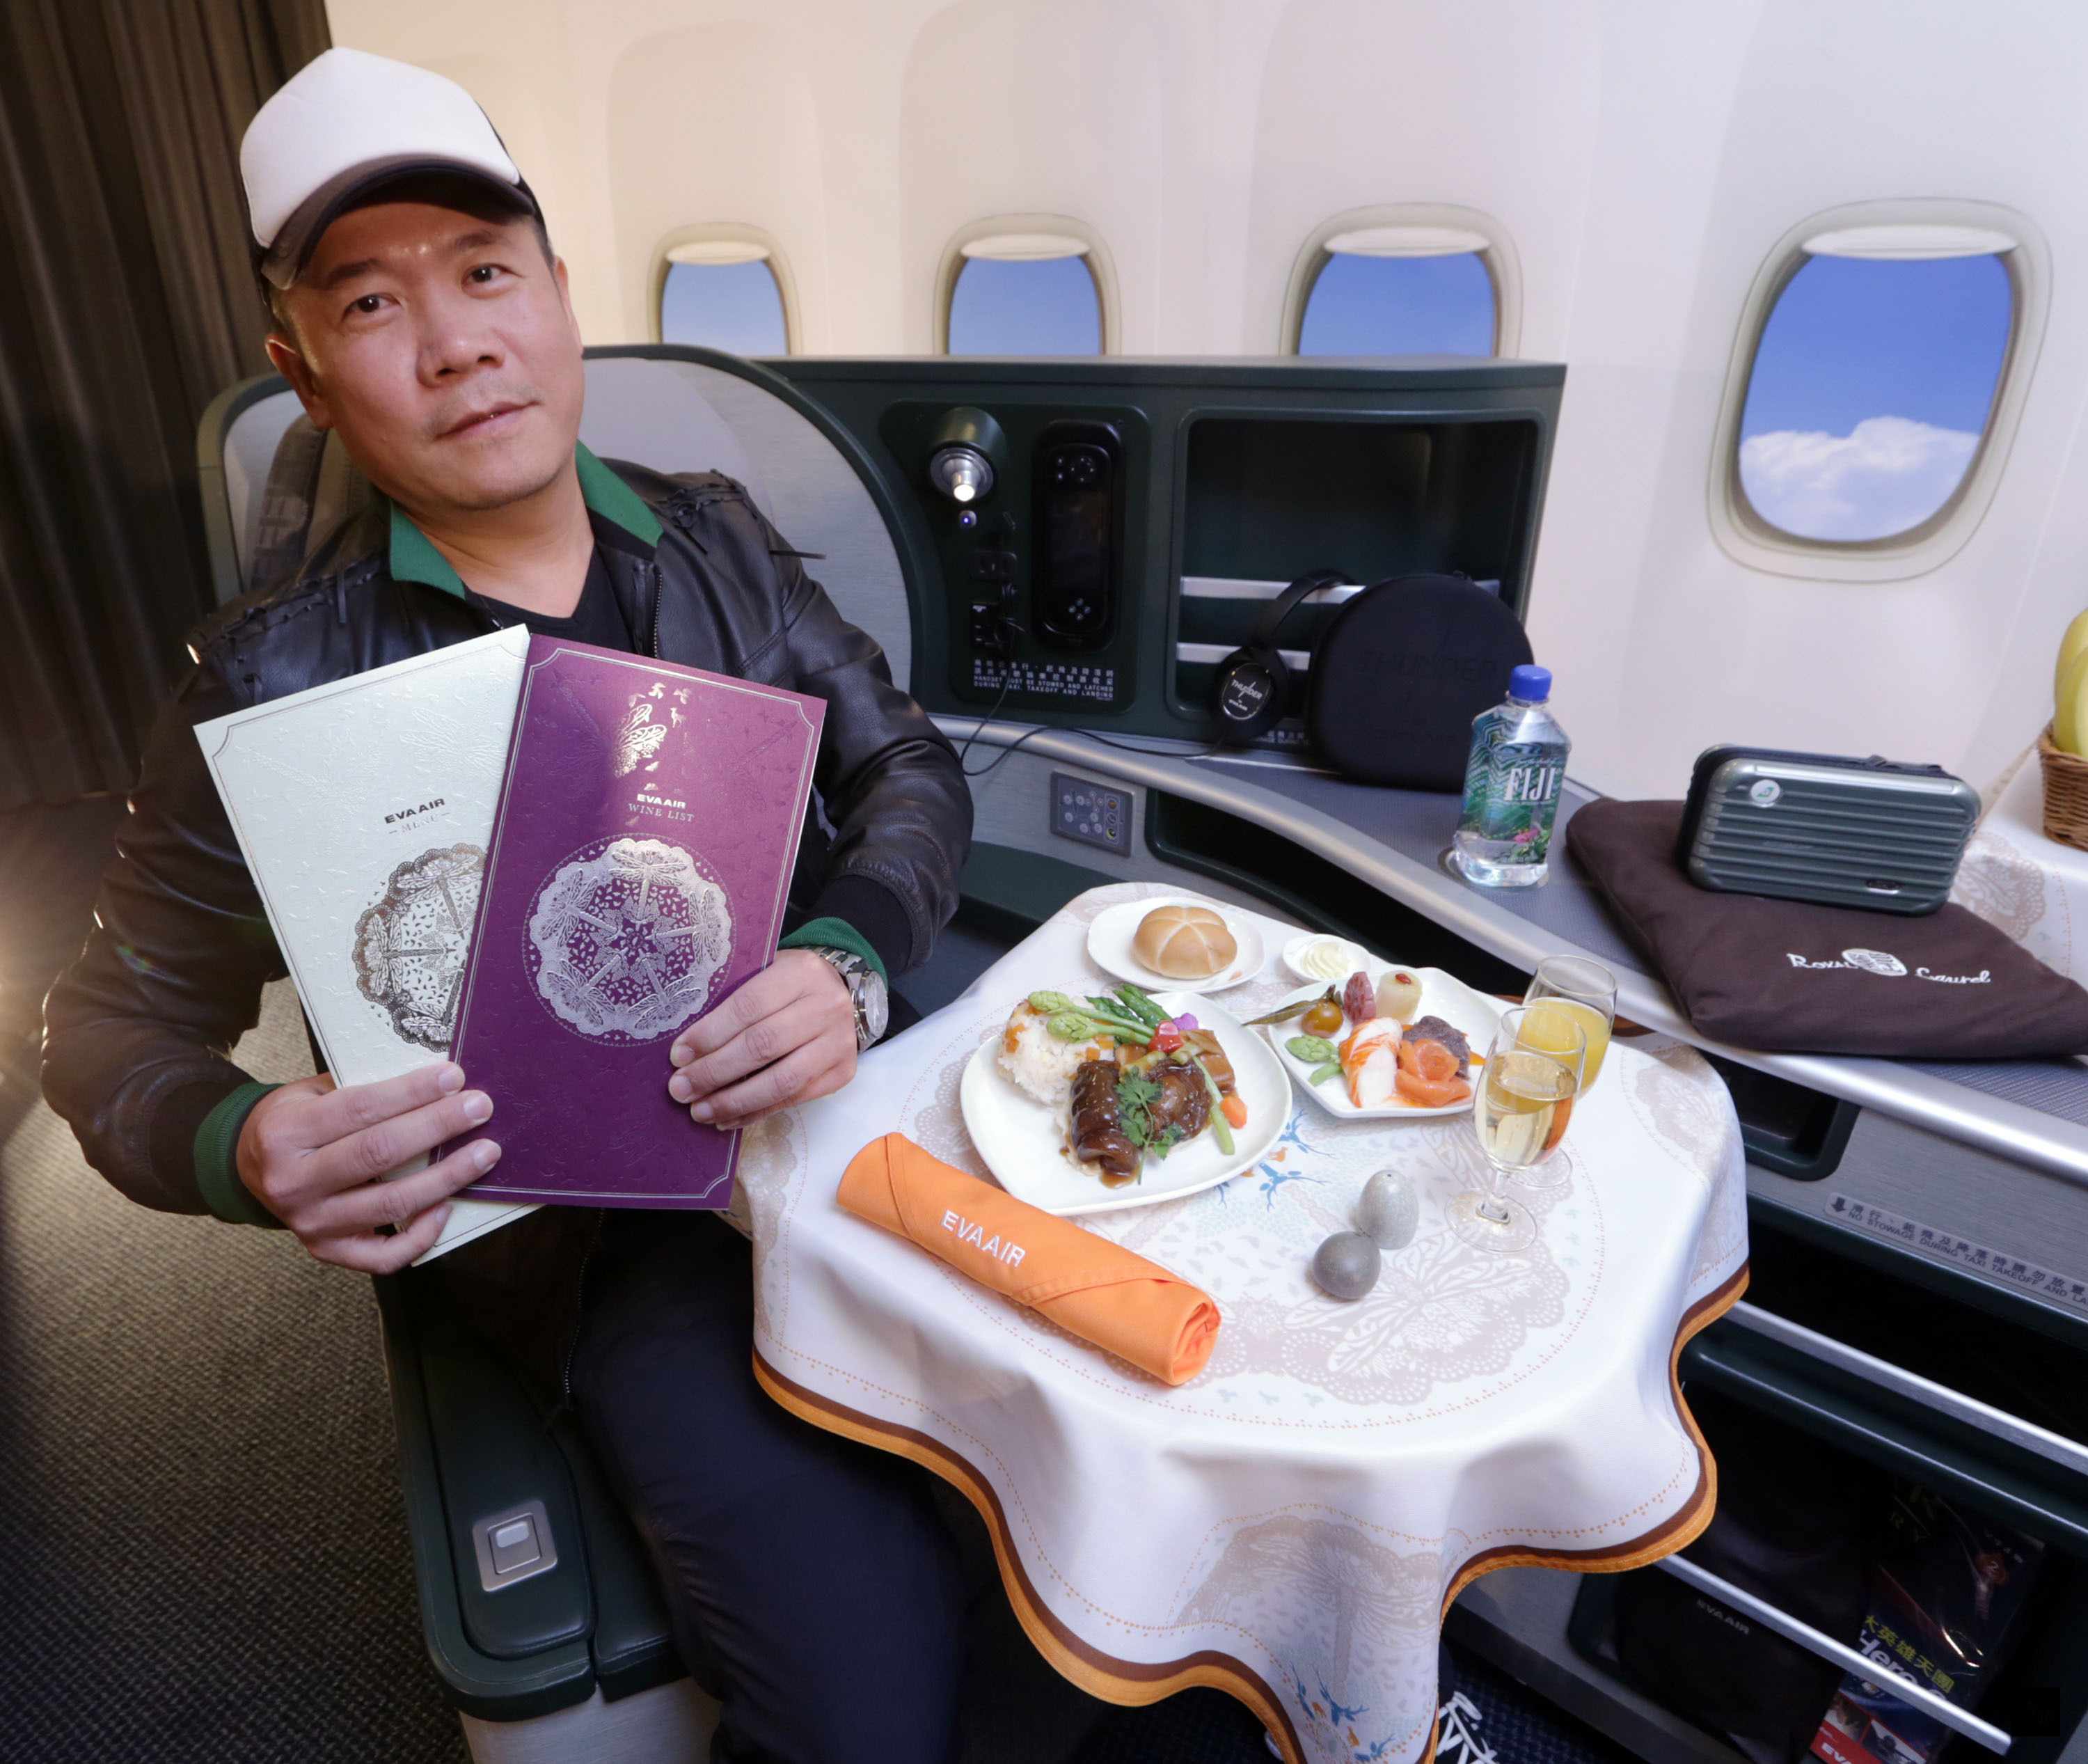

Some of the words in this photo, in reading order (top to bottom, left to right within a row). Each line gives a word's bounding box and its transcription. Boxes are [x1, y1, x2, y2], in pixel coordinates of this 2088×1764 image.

[974, 681, 1000, 689] DURING
[1082, 690, 1113, 698] LANDING
[1231, 679, 1263, 700] THUNDER
[1504, 767, 1557, 801] FIJI
[628, 803, 663, 817] WINE
[667, 810, 695, 822] LIST
[1848, 1211, 1863, 1221] NO
[1867, 1218, 1915, 1241] STOWAGE
[1920, 1238, 1959, 1257] DURING
[1963, 1254, 1986, 1268] TAXI
[1991, 1263, 2039, 1286] TAKEOFF
[2043, 1285, 2067, 1298] AND
[2072, 1293, 2088, 1307] LA
[1865, 1614, 1954, 1694] 大英雄天團
[1821, 1742, 1853, 1764] EV
